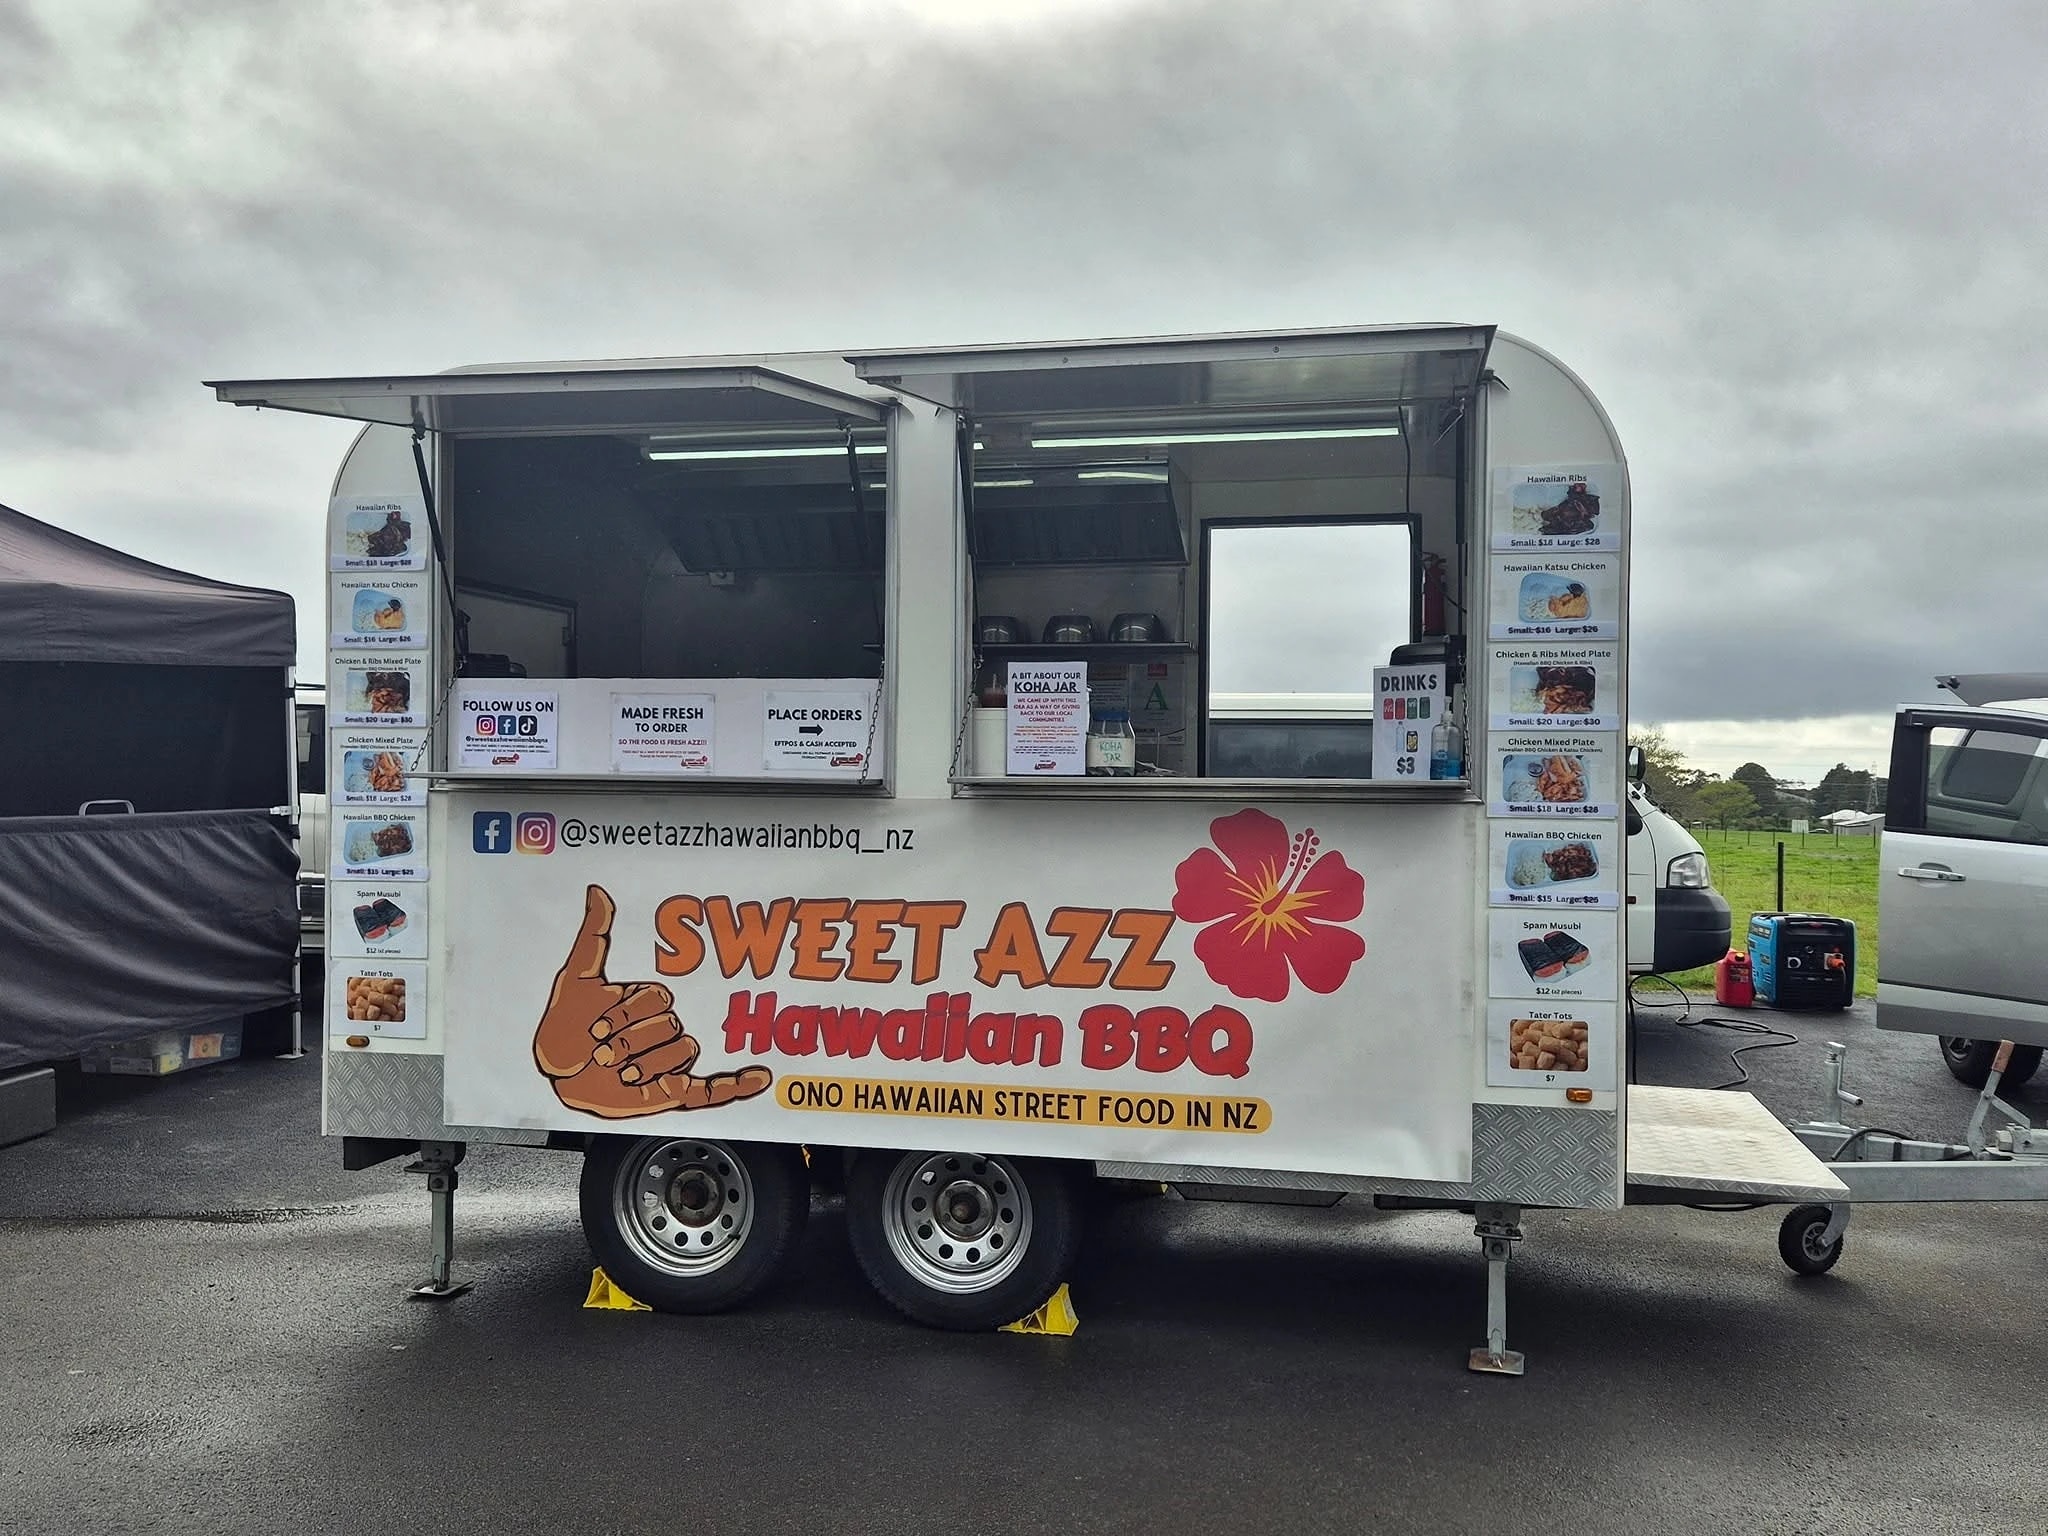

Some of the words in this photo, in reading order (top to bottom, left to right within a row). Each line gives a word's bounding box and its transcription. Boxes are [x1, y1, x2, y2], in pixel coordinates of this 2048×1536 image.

[1527, 475, 1567, 483] Hawaiian
[1568, 474, 1587, 482] Ribs
[1510, 539, 1536, 547] Small:
[1584, 538, 1601, 546] $28
[1503, 564, 1543, 572] Hawaiian
[1544, 563, 1569, 571] Katsu
[1570, 562, 1606, 571] Chicken
[391, 581, 418, 589] Chicken
[1582, 625, 1599, 633] $26
[1495, 650, 1530, 659] Chicken
[1540, 650, 1558, 658] Ribs
[1560, 650, 1586, 658] Mixed
[1588, 650, 1611, 658] Plate
[1011, 672, 1018, 680] A
[1019, 672, 1032, 680] BIT
[1033, 672, 1062, 680] ABOUT
[1063, 672, 1081, 680] OUR
[1014, 681, 1051, 692] KOHA
[1054, 681, 1077, 692] JAR
[1380, 674, 1438, 692] DRINKS
[1144, 681, 1168, 710] A
[462, 700, 513, 712] FOLLOW
[516, 701, 532, 712] US
[535, 701, 554, 712] ON
[621, 707, 659, 719] MADE
[662, 707, 704, 720] FRESH
[768, 709, 808, 720] PLACE
[811, 709, 862, 721] ORDERS
[1536, 718, 1553, 726] $20
[1583, 718, 1601, 726] $30
[635, 723, 650, 733] TO
[652, 723, 688, 733] ORDER
[347, 736, 374, 744] Chicken
[1508, 738, 1542, 746] Chicken
[1544, 738, 1571, 746] Mixed
[1572, 738, 1596, 746] Plate
[1099, 741, 1122, 751] KOHA
[1103, 752, 1121, 762] JAR
[1396, 756, 1415, 775] $3
[1537, 805, 1552, 813] $18
[1555, 805, 1582, 815] Large:
[1583, 805, 1599, 813] $28
[560, 818, 914, 855] @sweetazzhawaiianbbq_nz
[1504, 831, 1544, 839] Hawaiian
[1546, 831, 1565, 840] BBQ
[1566, 832, 1602, 840] Chicken
[356, 890, 376, 899] Spam
[1536, 894, 1552, 903] $15
[1583, 895, 1599, 904] $25
[1523, 921, 1548, 931] Spam
[1549, 922, 1582, 930] Musubi
[654, 893, 967, 986] SWEET
[973, 901, 1177, 992] AZZ
[360, 969, 377, 977] Tater
[378, 970, 394, 978] Tots
[1535, 987, 1550, 995] $12
[1528, 1011, 1552, 1019] Tater
[1553, 1012, 1573, 1020] Tots
[373, 1024, 381, 1032] $7
[721, 989, 1064, 1068] Hawaiian
[1078, 1003, 1254, 1079] BBQ
[1545, 1074, 1555, 1082] $7
[787, 1080, 844, 1108] ONO
[853, 1083, 983, 1116] HAWAIIAN
[994, 1090, 1087, 1121] STREET
[1099, 1097, 1175, 1125] FOOD
[1186, 1100, 1212, 1128] IN
[1223, 1102, 1258, 1130] NZ
